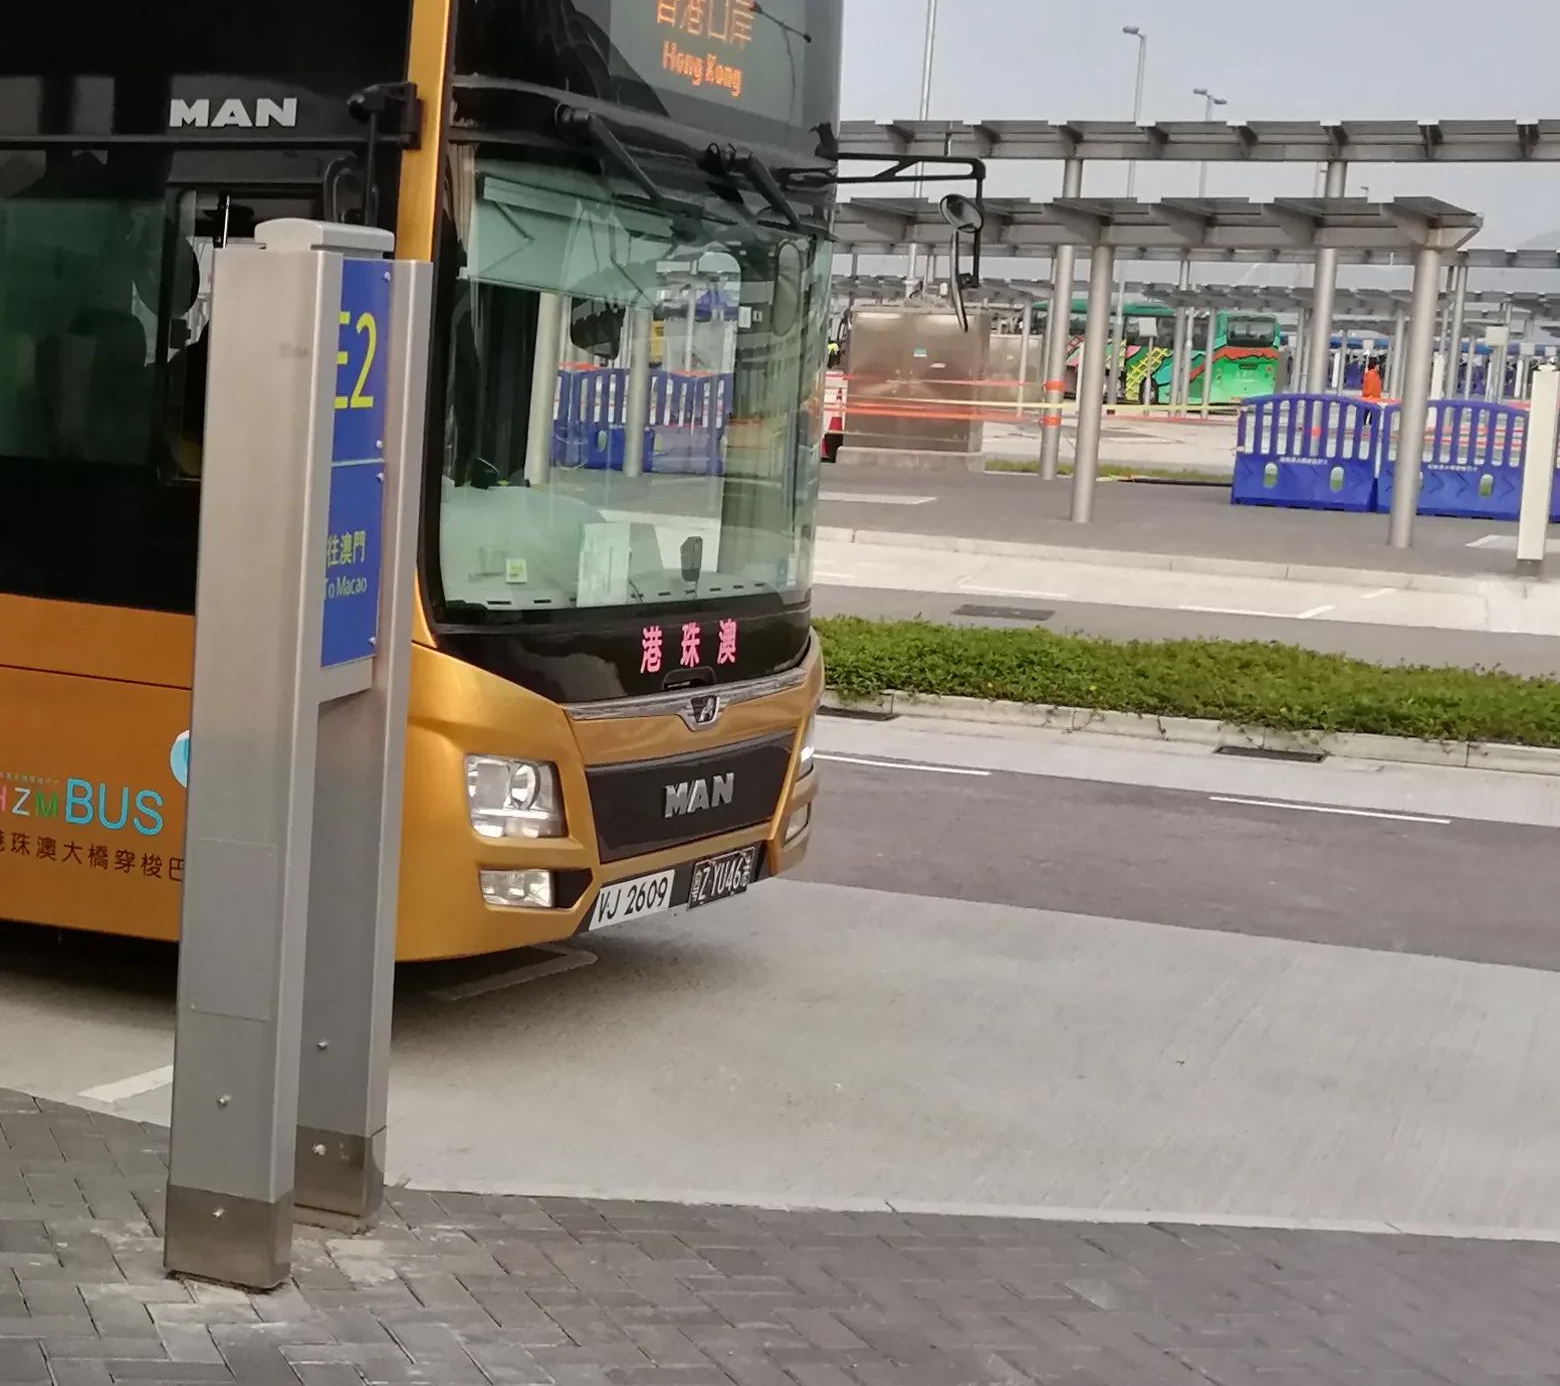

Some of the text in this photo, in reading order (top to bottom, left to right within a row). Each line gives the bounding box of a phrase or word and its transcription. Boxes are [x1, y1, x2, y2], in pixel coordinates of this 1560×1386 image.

[661, 41, 743, 97] Hong Kong
[169, 97, 297, 127] MAN
[336, 575, 368, 597] Macao
[640, 618, 737, 674] 港珠澳
[664, 772, 735, 819] MAN
[598, 876, 669, 923] VJ 2609
